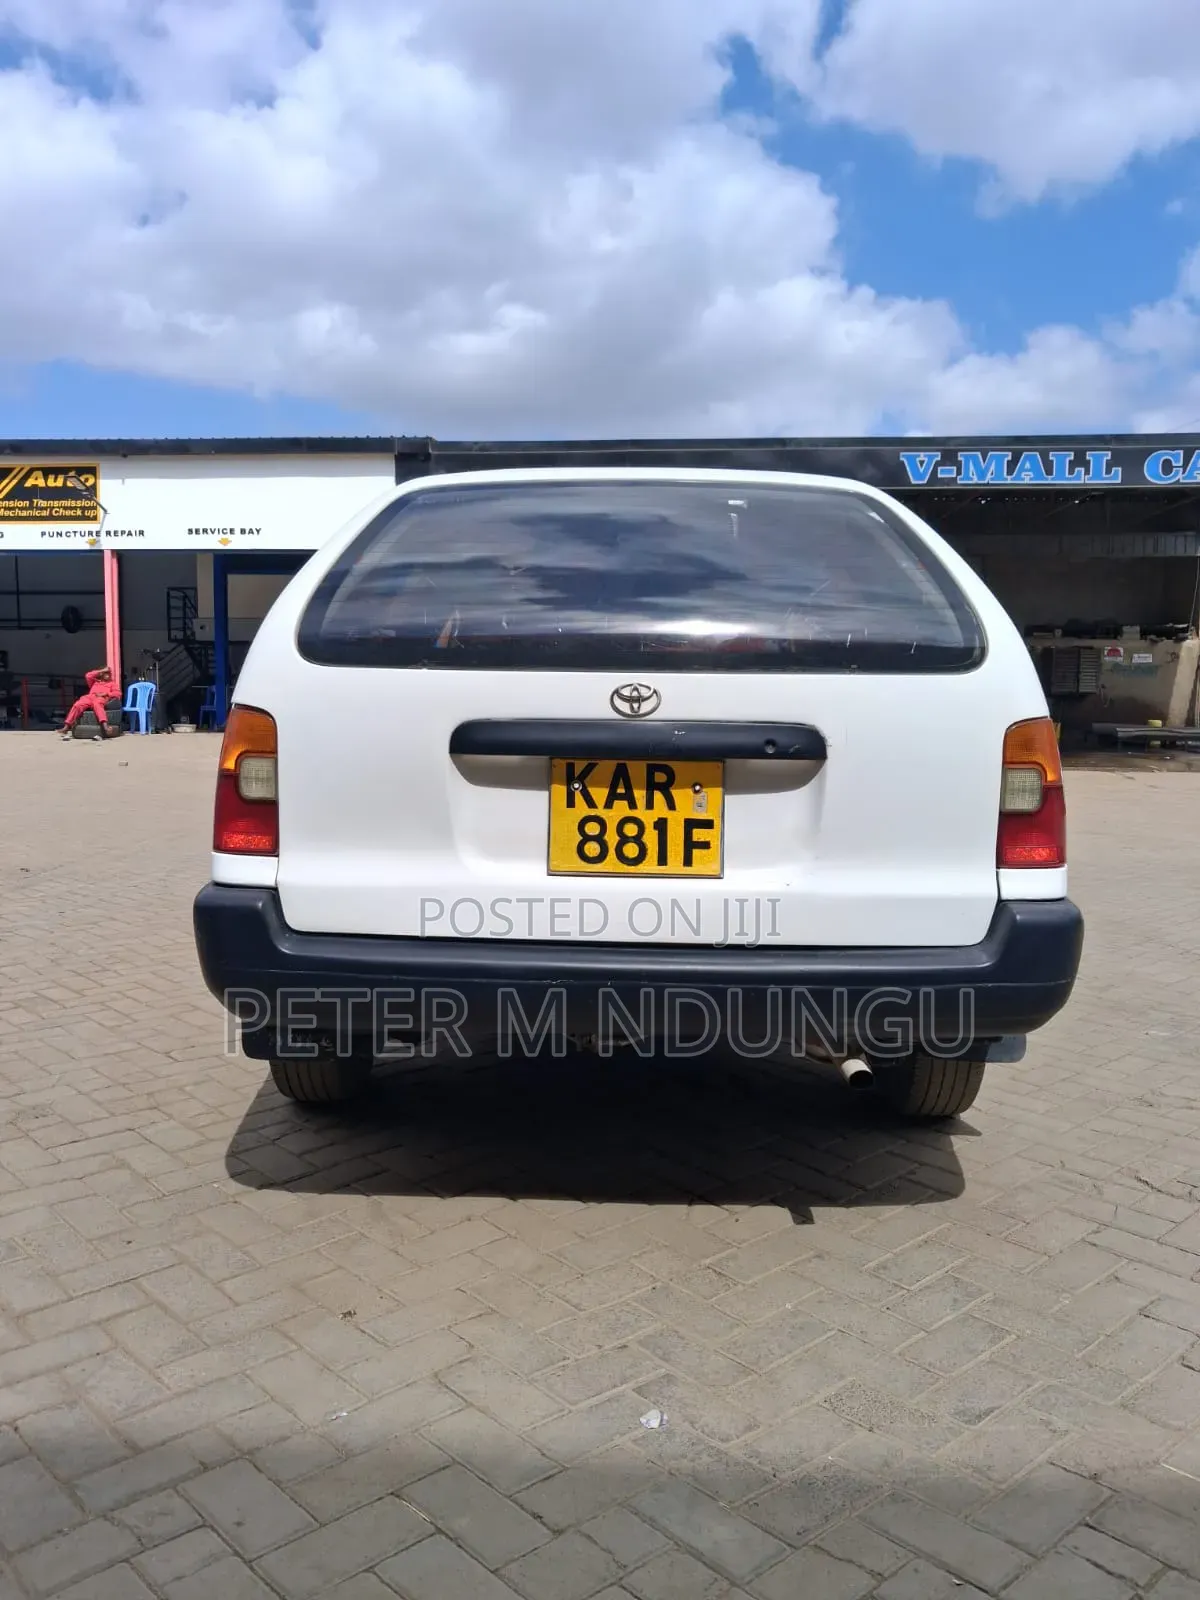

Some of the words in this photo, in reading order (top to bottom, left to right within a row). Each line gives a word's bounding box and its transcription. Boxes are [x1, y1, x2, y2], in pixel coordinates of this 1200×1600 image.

[900, 451, 1122, 484] V-MALL
[32, 499, 96, 507] Transmission
[52, 508, 82, 516] Check
[40, 530, 101, 538] PUNCTURE
[105, 529, 145, 537] REPAIR
[187, 527, 236, 535] SERVICE
[240, 527, 262, 535] BAY
[565, 761, 677, 811] KAR
[576, 814, 715, 868] 881F
